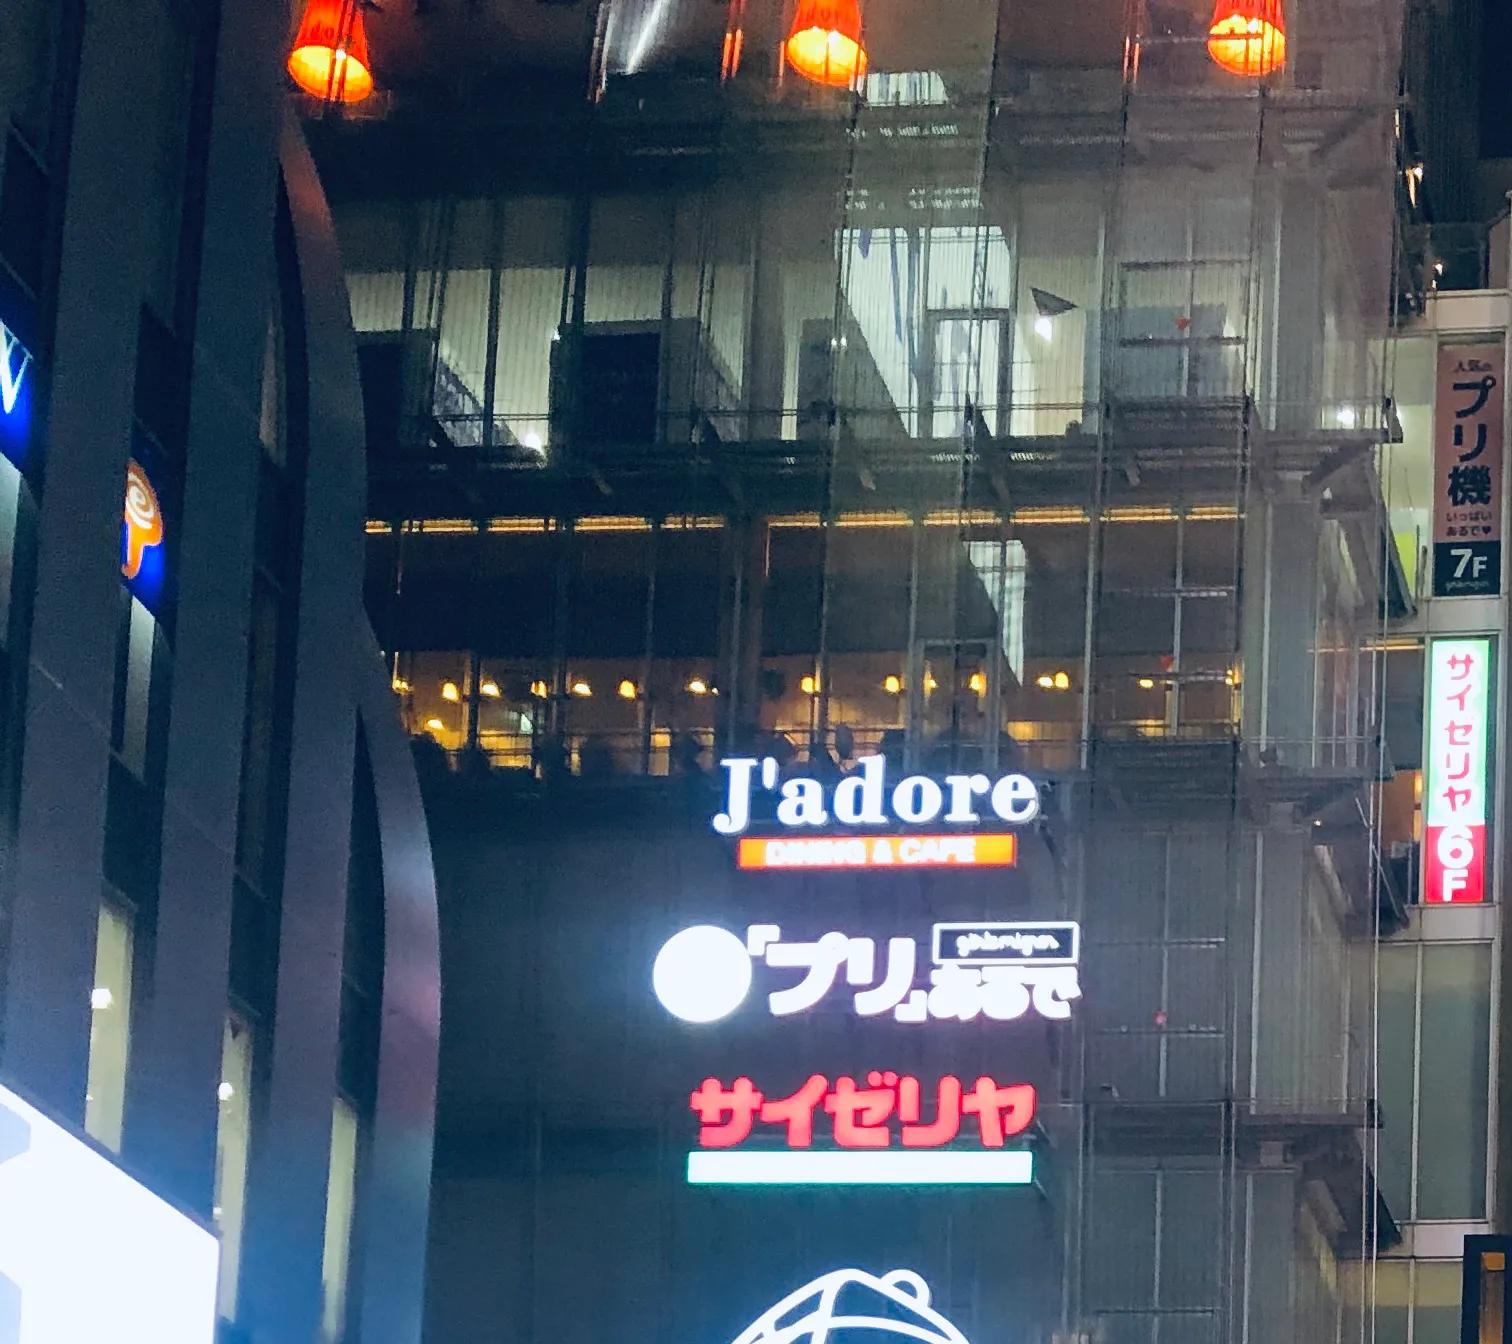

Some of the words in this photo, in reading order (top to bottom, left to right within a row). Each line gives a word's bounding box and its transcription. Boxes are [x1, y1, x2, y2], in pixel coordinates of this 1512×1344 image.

[1448, 375, 1497, 507] プリ機
[1446, 511, 1492, 523] いっぱい
[1450, 548, 1488, 579] 7F
[712, 754, 1040, 835] J'adore
[899, 837, 977, 864] CAFE
[1437, 823, 1474, 901] 6F
[690, 1070, 1036, 1147] サイゼリヤ
